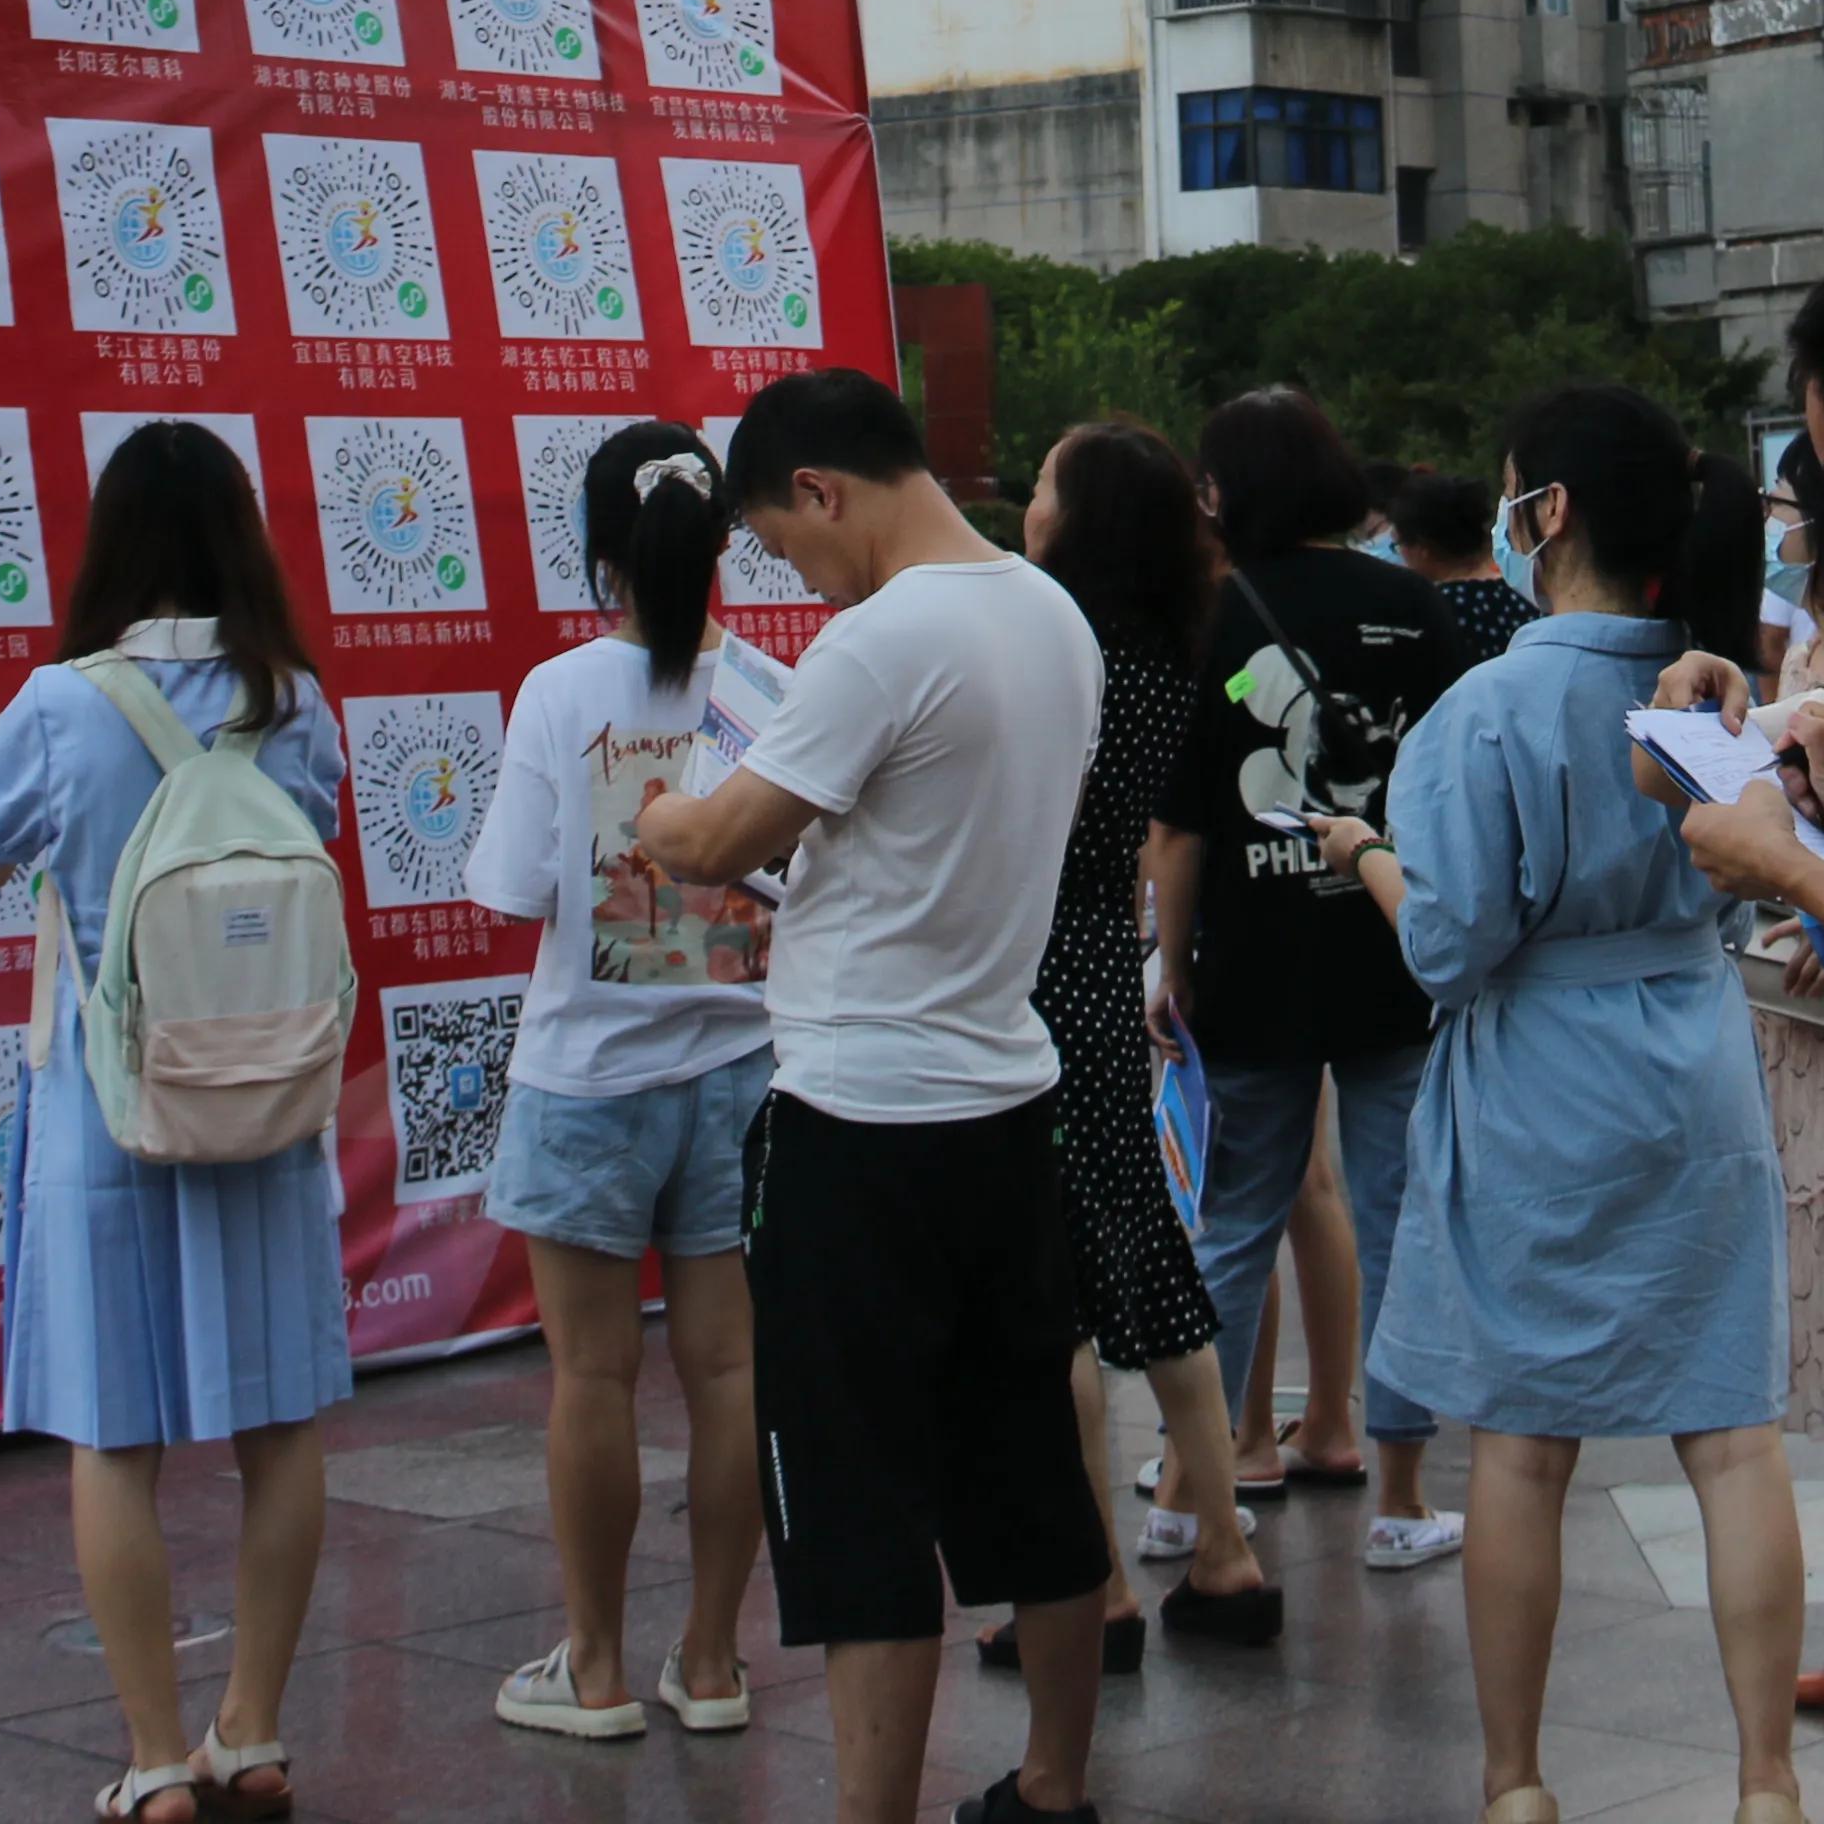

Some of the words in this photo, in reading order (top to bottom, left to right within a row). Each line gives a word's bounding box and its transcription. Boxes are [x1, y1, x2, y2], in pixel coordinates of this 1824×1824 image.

[56, 48, 184, 81] 长阳爱尔眼科
[252, 63, 412, 98] 湖北康农种业股份
[297, 92, 376, 119] 有限公司
[438, 79, 627, 113] 湖北一致魔芋生物科技
[481, 105, 595, 134] 股份有限公司
[672, 118, 776, 146] 发展有限公司
[94, 334, 222, 363] 长江证券股份
[119, 361, 205, 388] 有限公司
[337, 366, 418, 392] 有限公司
[523, 369, 637, 393] 咨询有限公司
[332, 620, 493, 648] 迈高精细高新材料
[1246, 836, 1328, 879] PHIL
[412, 930, 491, 961] 有限公司
